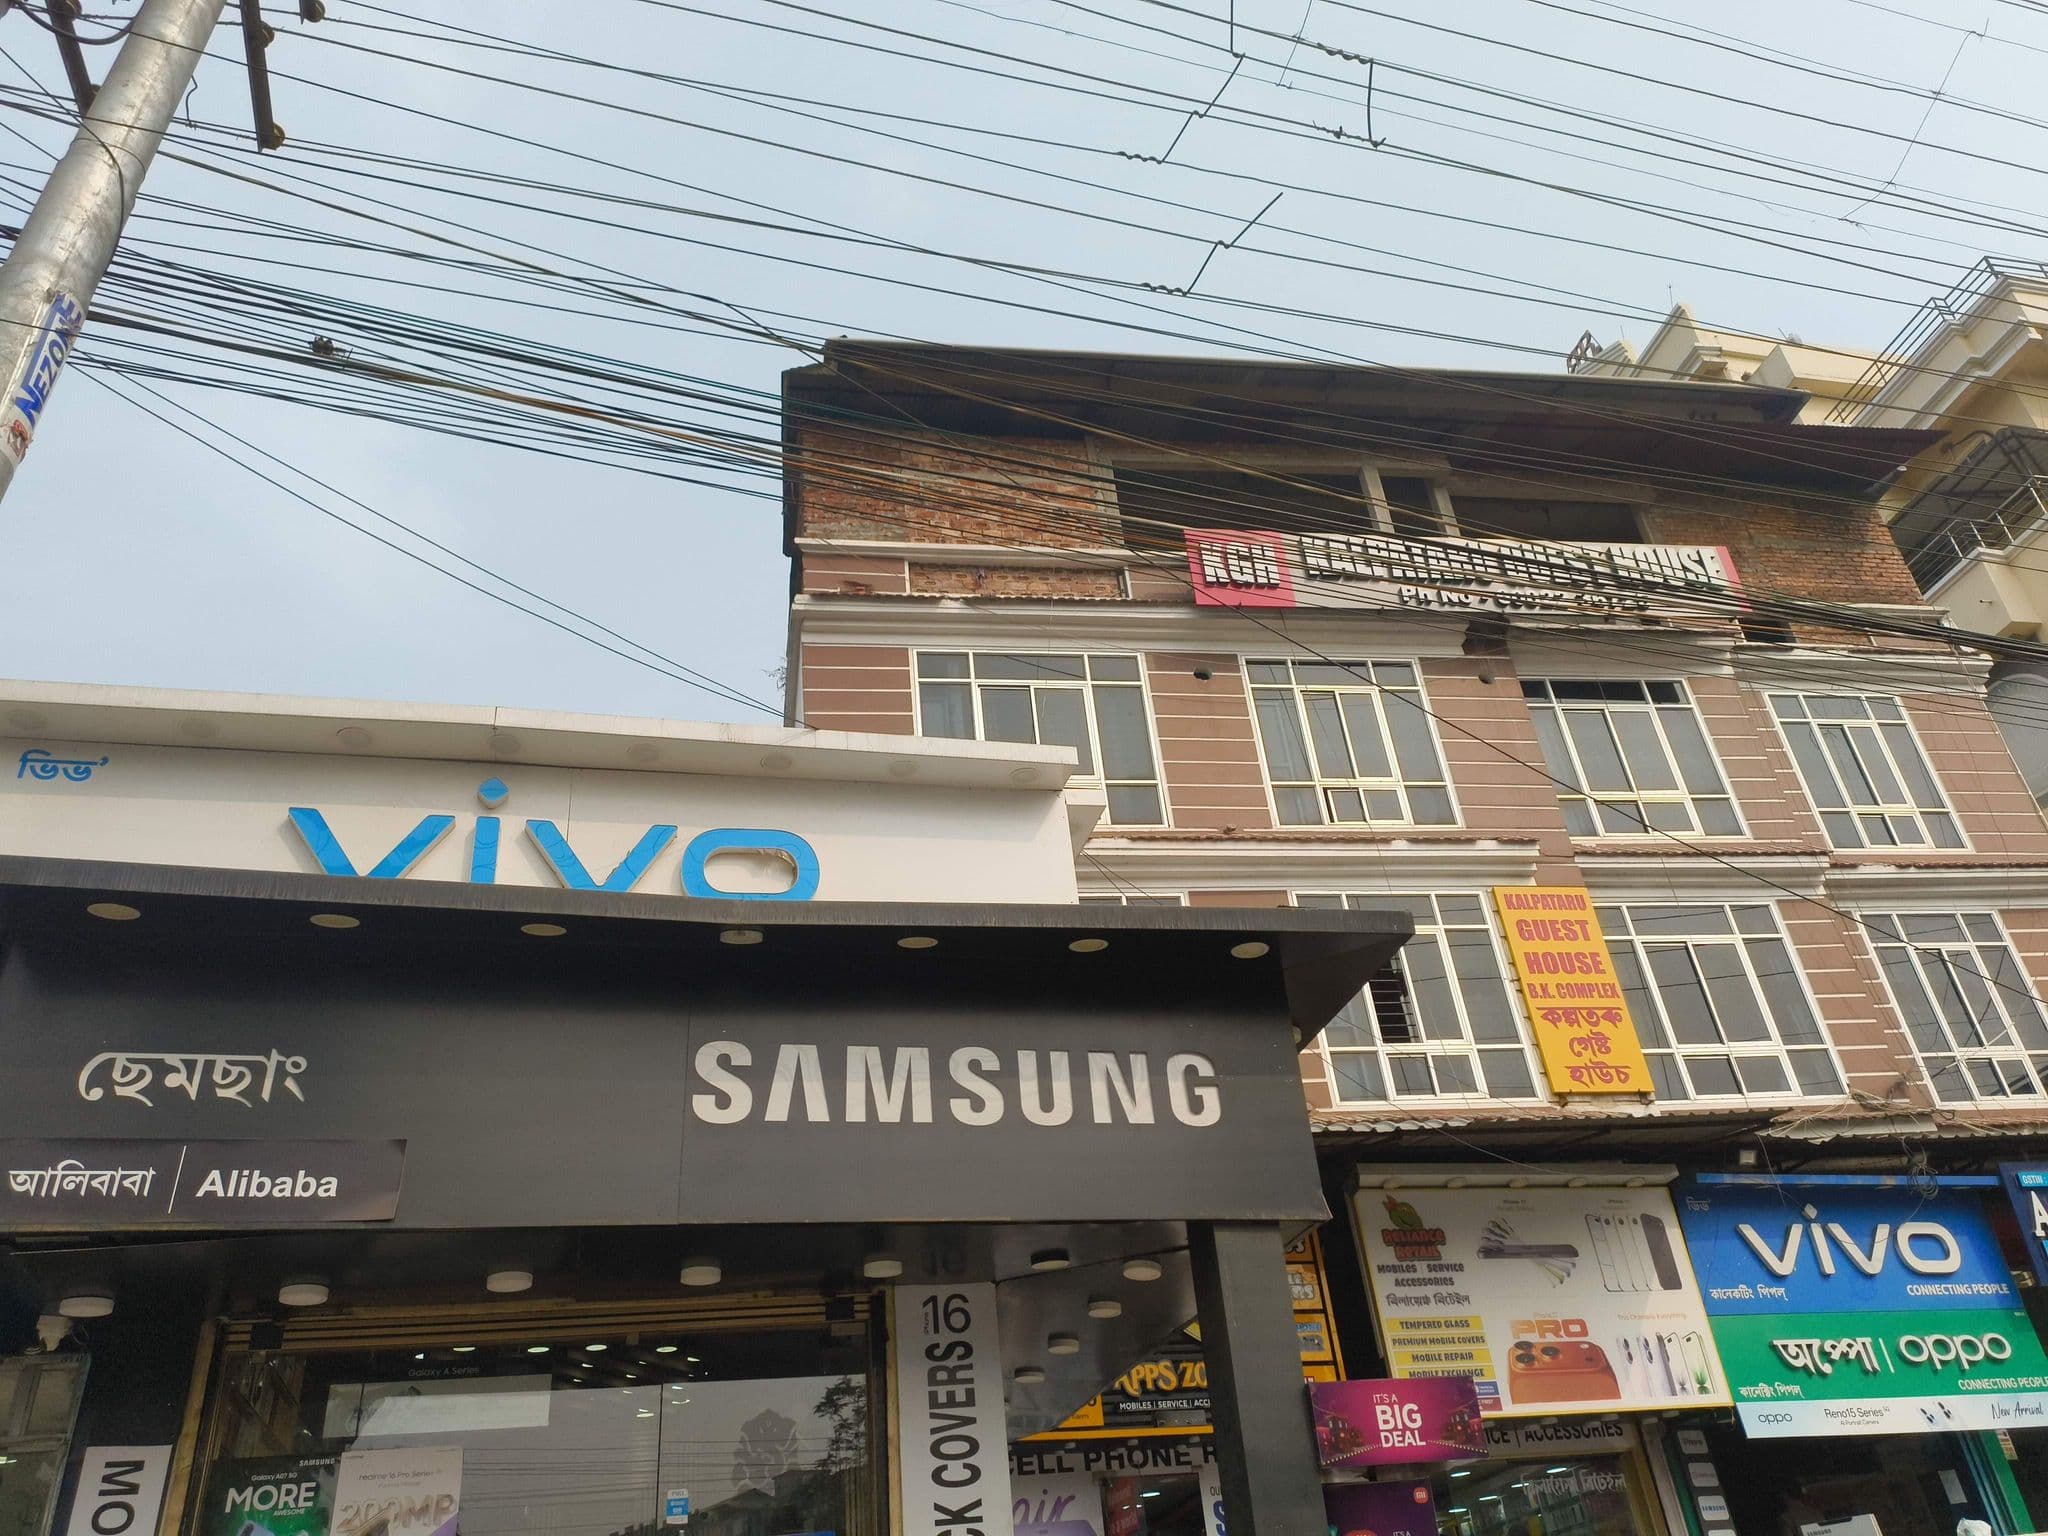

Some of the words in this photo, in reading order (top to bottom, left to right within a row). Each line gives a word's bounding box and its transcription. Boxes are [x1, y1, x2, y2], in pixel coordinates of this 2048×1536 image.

[288, 777, 820, 902] vivo
[1503, 893, 1588, 911] KALPATARU
[1516, 919, 1591, 942] GUEST
[1524, 951, 1607, 975] HOUSE
[1529, 983, 1556, 999] B.K.
[1557, 982, 1621, 1000] COMPLEX
[78, 1048, 308, 1108] ছেমছাং
[692, 1041, 1222, 1128] SAMSUNG
[1564, 1058, 1633, 1088] হাউচ
[8, 1159, 157, 1199] আলিবাবা
[196, 1169, 339, 1198] Alibaba
[1735, 1203, 1962, 1277] vivo
[1906, 1284, 1971, 1296] CONNECTING
[1973, 1283, 2010, 1294] PEOPLE
[922, 1293, 972, 1334] 16
[1400, 1321, 1442, 1330] TEMPERED
[1444, 1320, 1470, 1329] GLASS
[1392, 1337, 1428, 1346] PREMIUM
[1429, 1336, 1456, 1345] MOBILE
[1457, 1335, 1485, 1344] COVERS
[1511, 1318, 1589, 1339] PRO
[1412, 1353, 1442, 1362] MOBILE
[1444, 1352, 1474, 1361] REPAIR
[1899, 1333, 2012, 1370] oppo
[1958, 1378, 2018, 1390] CONNECTING
[1120, 1401, 1151, 1410] MOBILES
[1158, 1400, 1188, 1409] SERVICE
[1373, 1394, 1389, 1403] IT'S
[1391, 1394, 1398, 1402] A
[925, 1340, 982, 1488] COVERS
[1375, 1403, 1422, 1430] BIG
[1824, 1408, 1856, 1418] Reno15
[1858, 1407, 1884, 1418] Series
[1380, 1431, 1426, 1448] DEAL
[1084, 1447, 1192, 1471] PHONE
[224, 1482, 316, 1513] MORE
